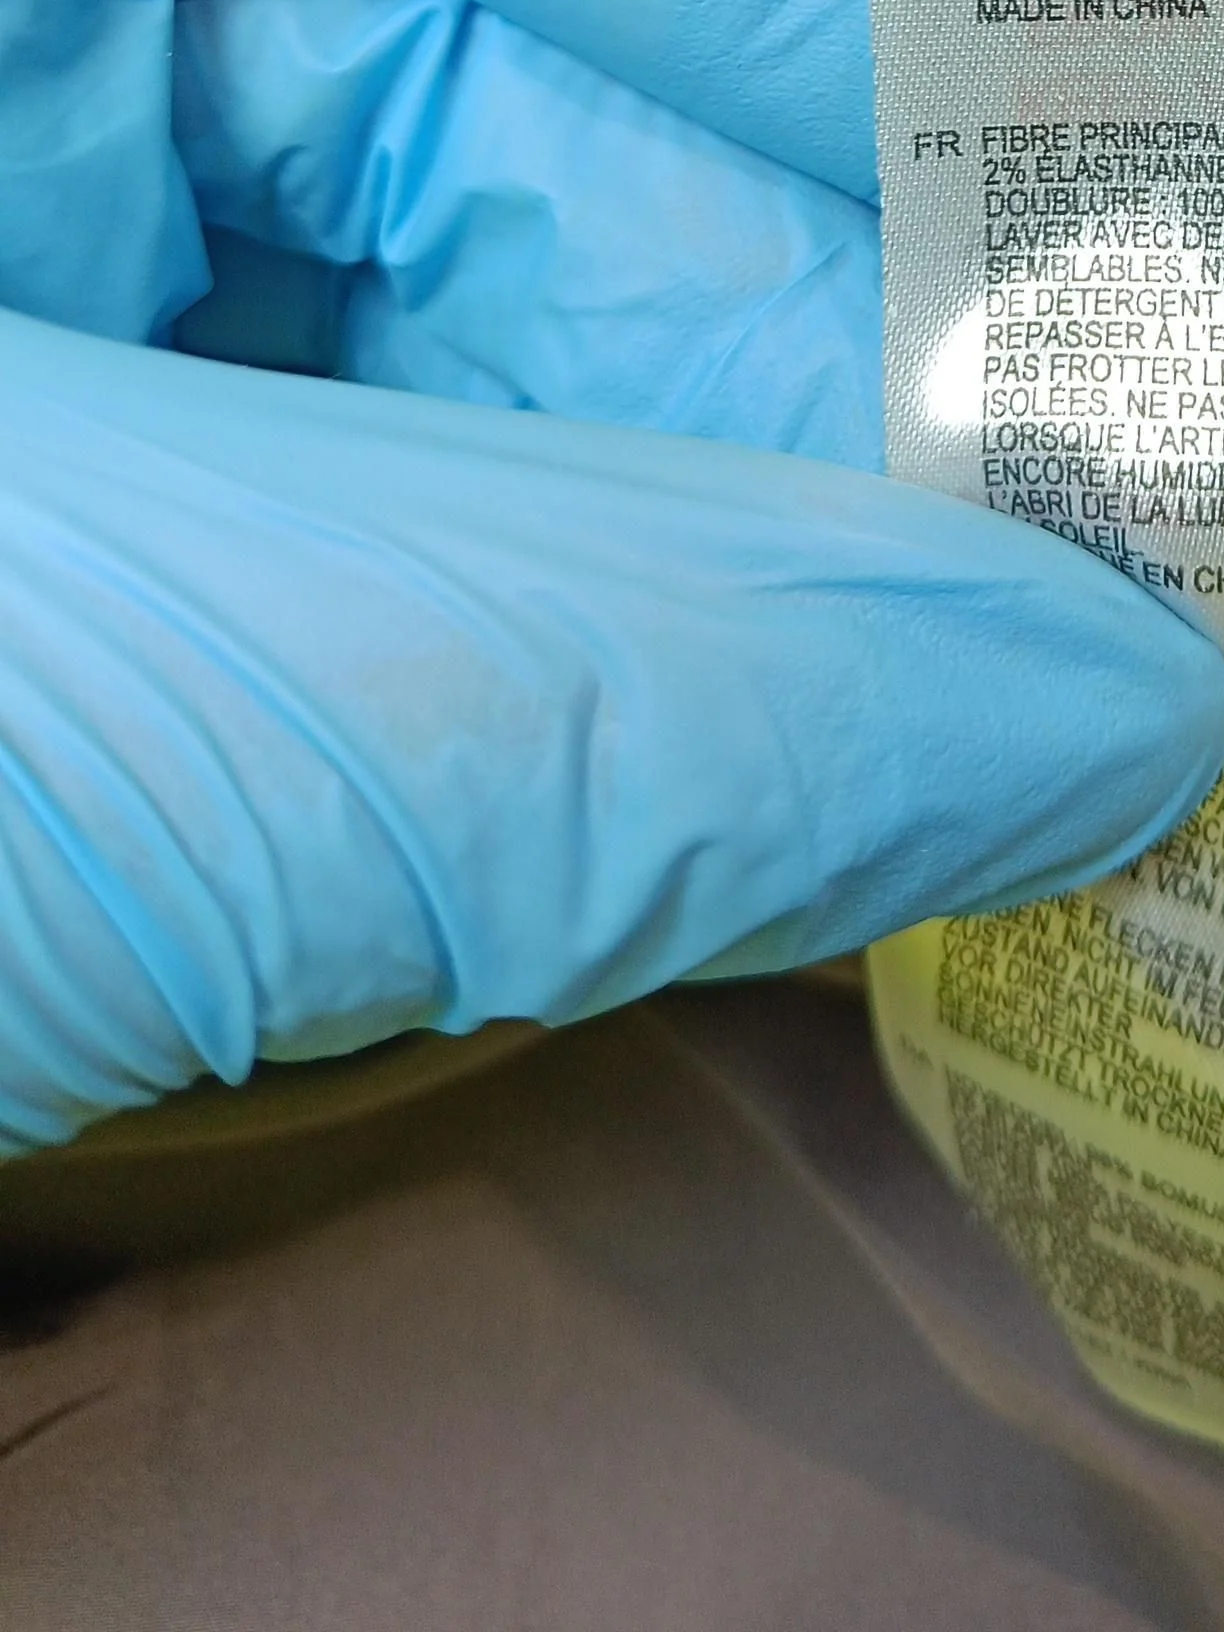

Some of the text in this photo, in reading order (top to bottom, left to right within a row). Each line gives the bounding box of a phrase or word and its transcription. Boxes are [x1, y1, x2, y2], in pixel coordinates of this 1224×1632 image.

[914, 132, 961, 161] FR
[982, 127, 1072, 153] FIBRE
[984, 159, 1027, 186] 2%
[986, 221, 1082, 251] LAVER
[1091, 221, 1172, 251] AVEC
[986, 255, 1193, 284] SEMBLABLES.
[986, 289, 1026, 317] DE
[1036, 282, 1219, 320] DÉTERGENT
[986, 320, 1144, 350] REPASSER
[984, 354, 1039, 385] PAS
[1050, 354, 1192, 387] FROTTER
[983, 380, 1115, 418] ISOLÉES.
[1128, 391, 1168, 419] NE
[982, 422, 1124, 455] LORSQUE
[985, 456, 1106, 488] ENCORE
[988, 489, 1072, 519] L'ABRI
[1082, 491, 1121, 521] DE
[1131, 497, 1170, 526] LA
[1143, 561, 1184, 591] EN
[1158, 862, 1216, 911] VON
[1090, 902, 1215, 979] FLECKEN
[1063, 921, 1141, 980] NICHT
[1144, 967, 1178, 1000] IM
[942, 935, 1133, 1039] VOR DIREKTER
